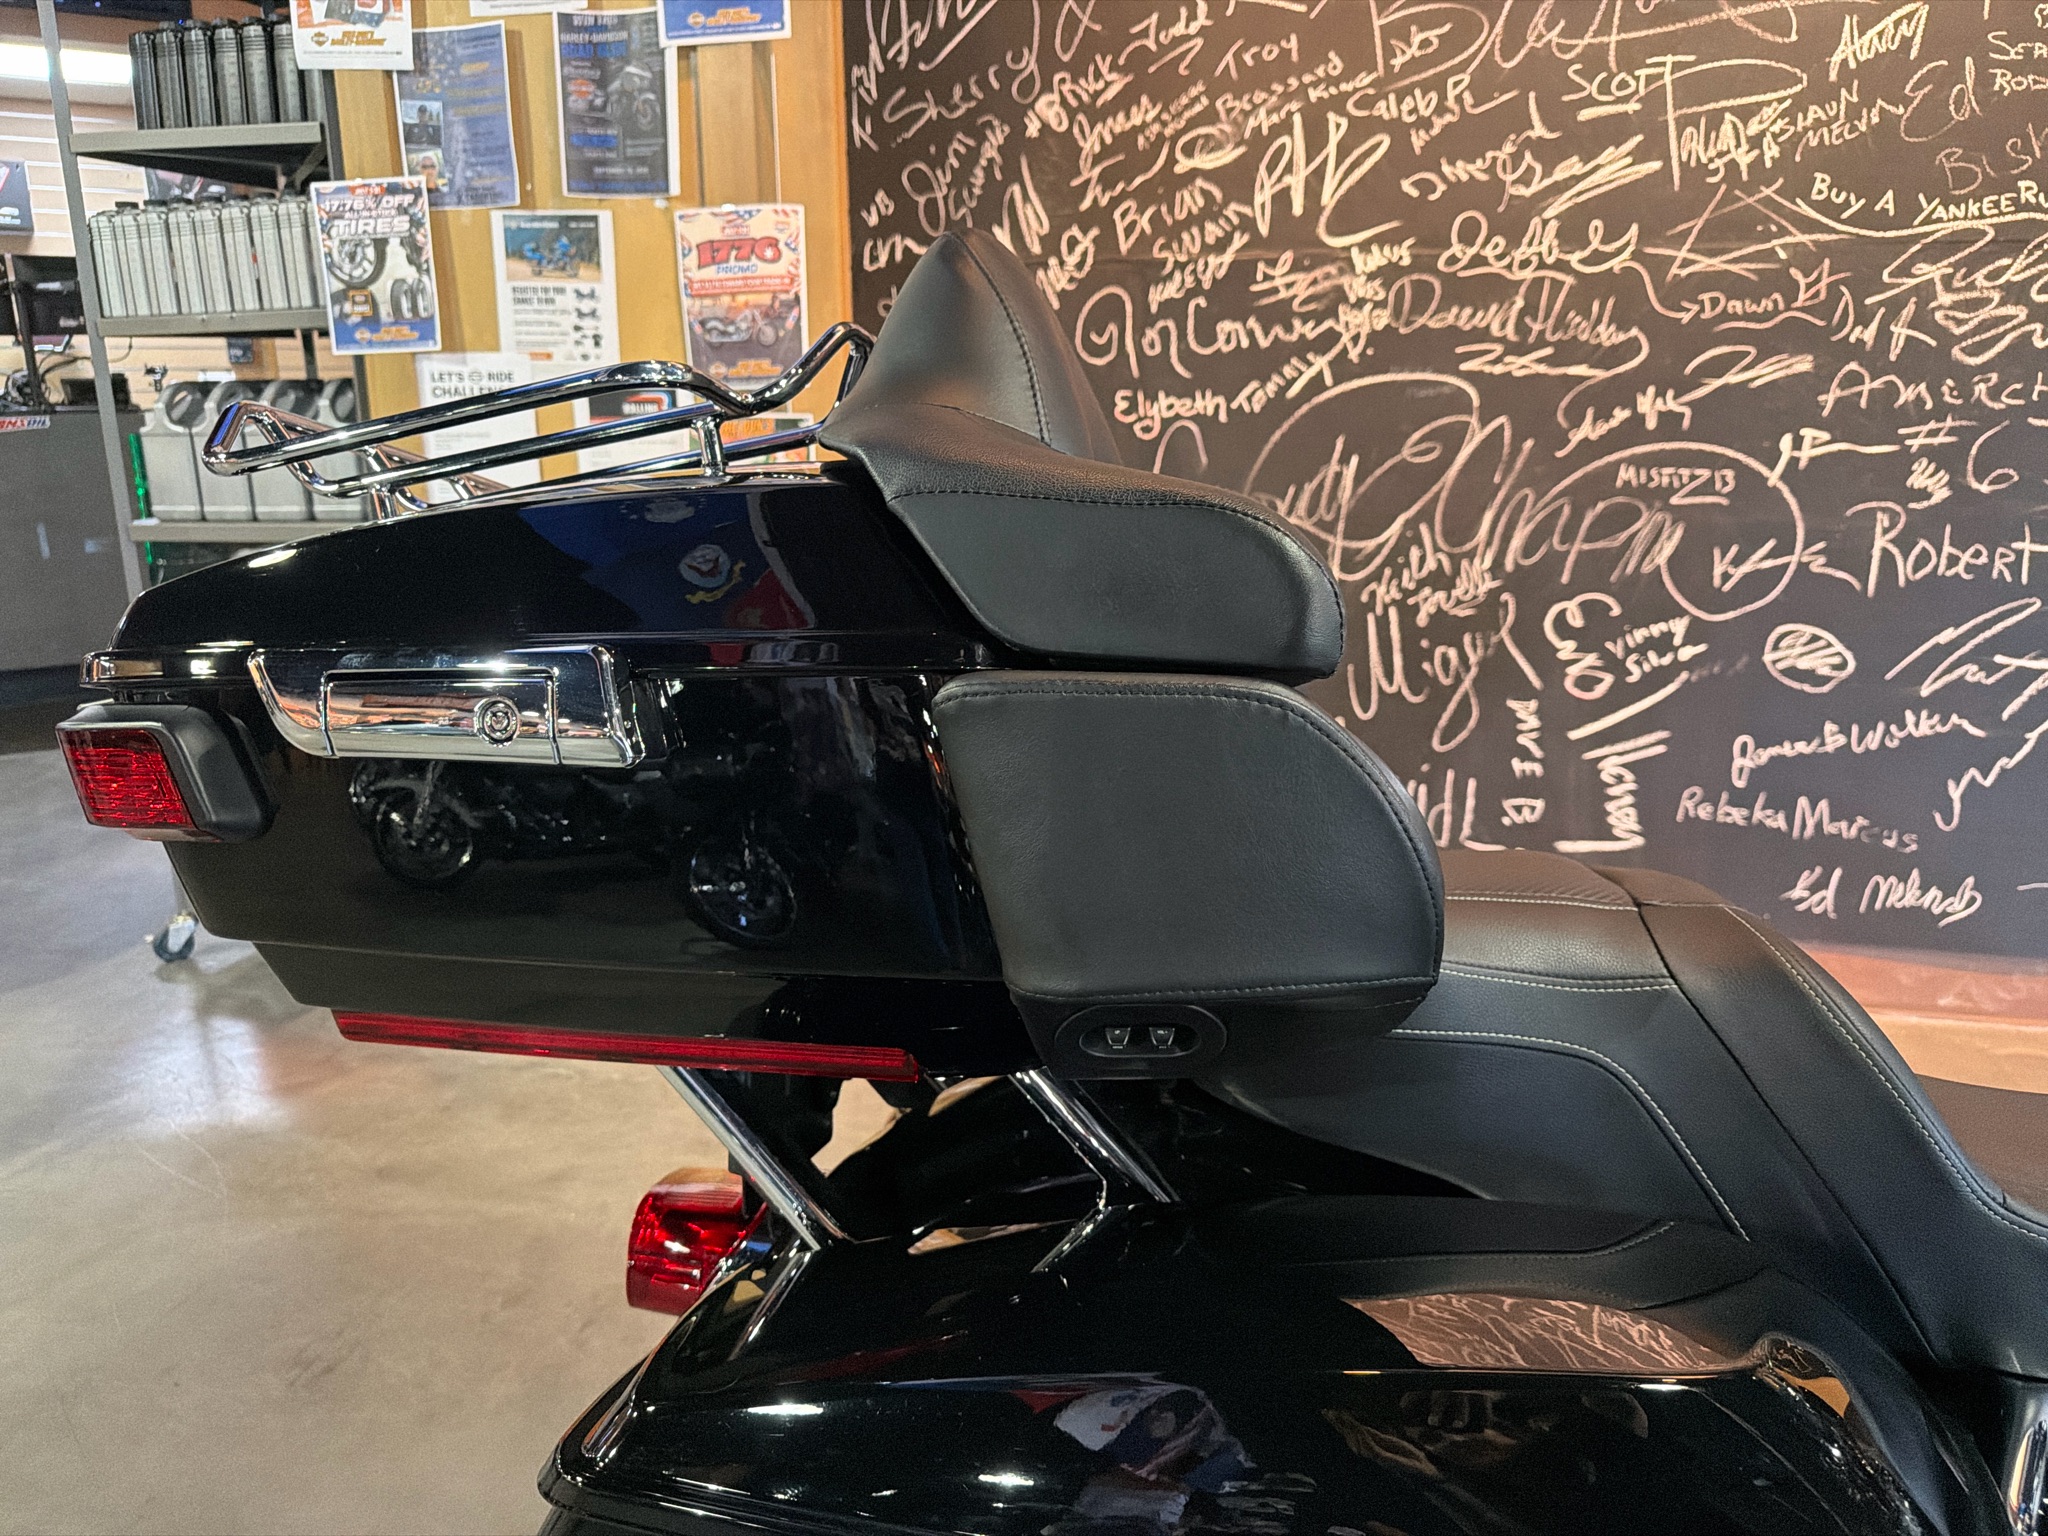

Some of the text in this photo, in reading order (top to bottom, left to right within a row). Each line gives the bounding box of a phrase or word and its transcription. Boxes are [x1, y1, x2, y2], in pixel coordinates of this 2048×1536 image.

[1214, 33, 1299, 81] Troy
[1346, 87, 1439, 123] Caleb
[1899, 56, 1983, 143] Ed
[380, 194, 415, 208] OFF
[1113, 177, 1223, 255] Brian
[1811, 171, 1867, 219] BUY
[1874, 189, 1896, 217] A
[1912, 192, 2018, 226] YANKEE
[333, 216, 411, 236] TIRES
[696, 236, 782, 270] 1776
[1697, 289, 1787, 320] Dawn
[430, 369, 515, 384] LET'S RIDE
[432, 385, 508, 399] CHALLEN
[1845, 501, 2048, 598] Robert
